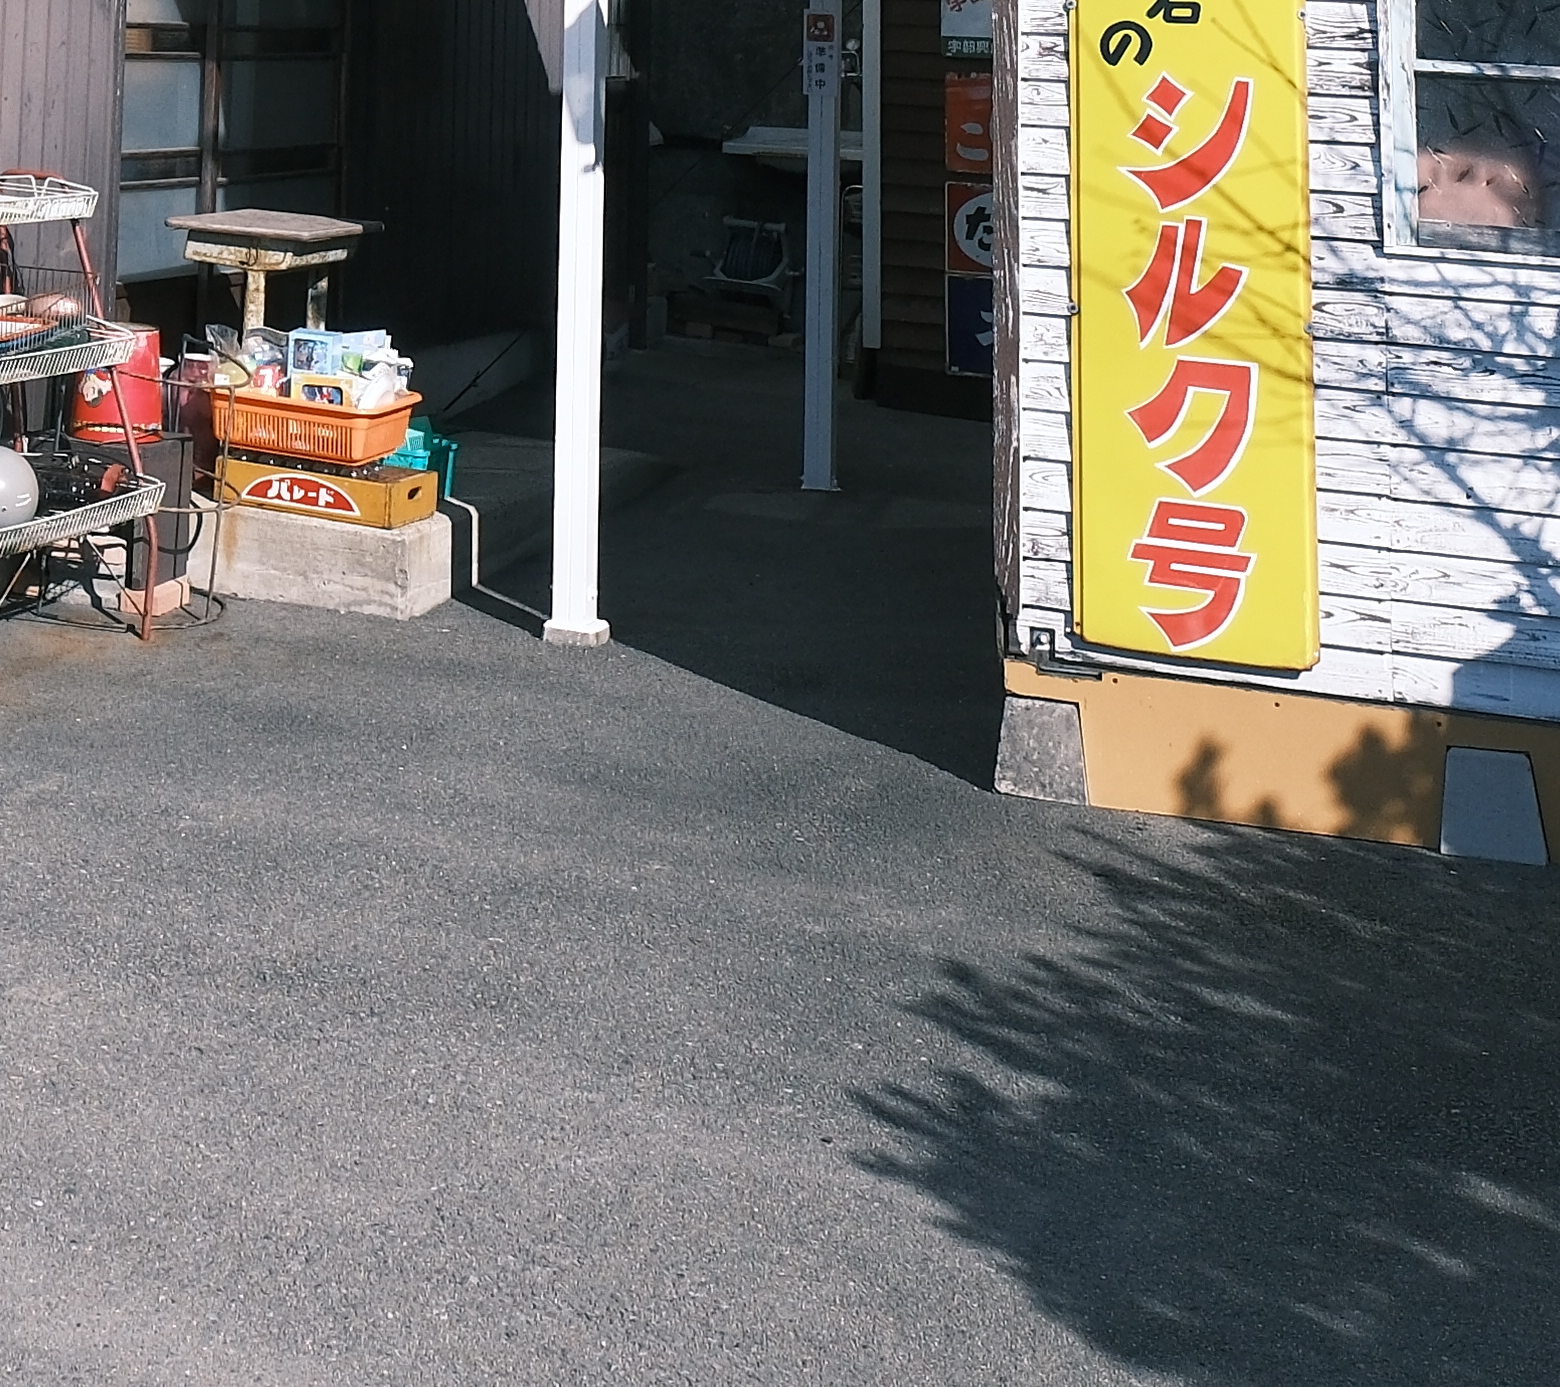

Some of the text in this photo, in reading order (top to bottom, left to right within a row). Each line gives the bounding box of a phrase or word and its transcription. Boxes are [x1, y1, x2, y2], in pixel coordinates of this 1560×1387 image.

[947, 38, 994, 55] 宇部興
[1116, 71, 1260, 653] シルク号
[266, 479, 336, 507] パレード
